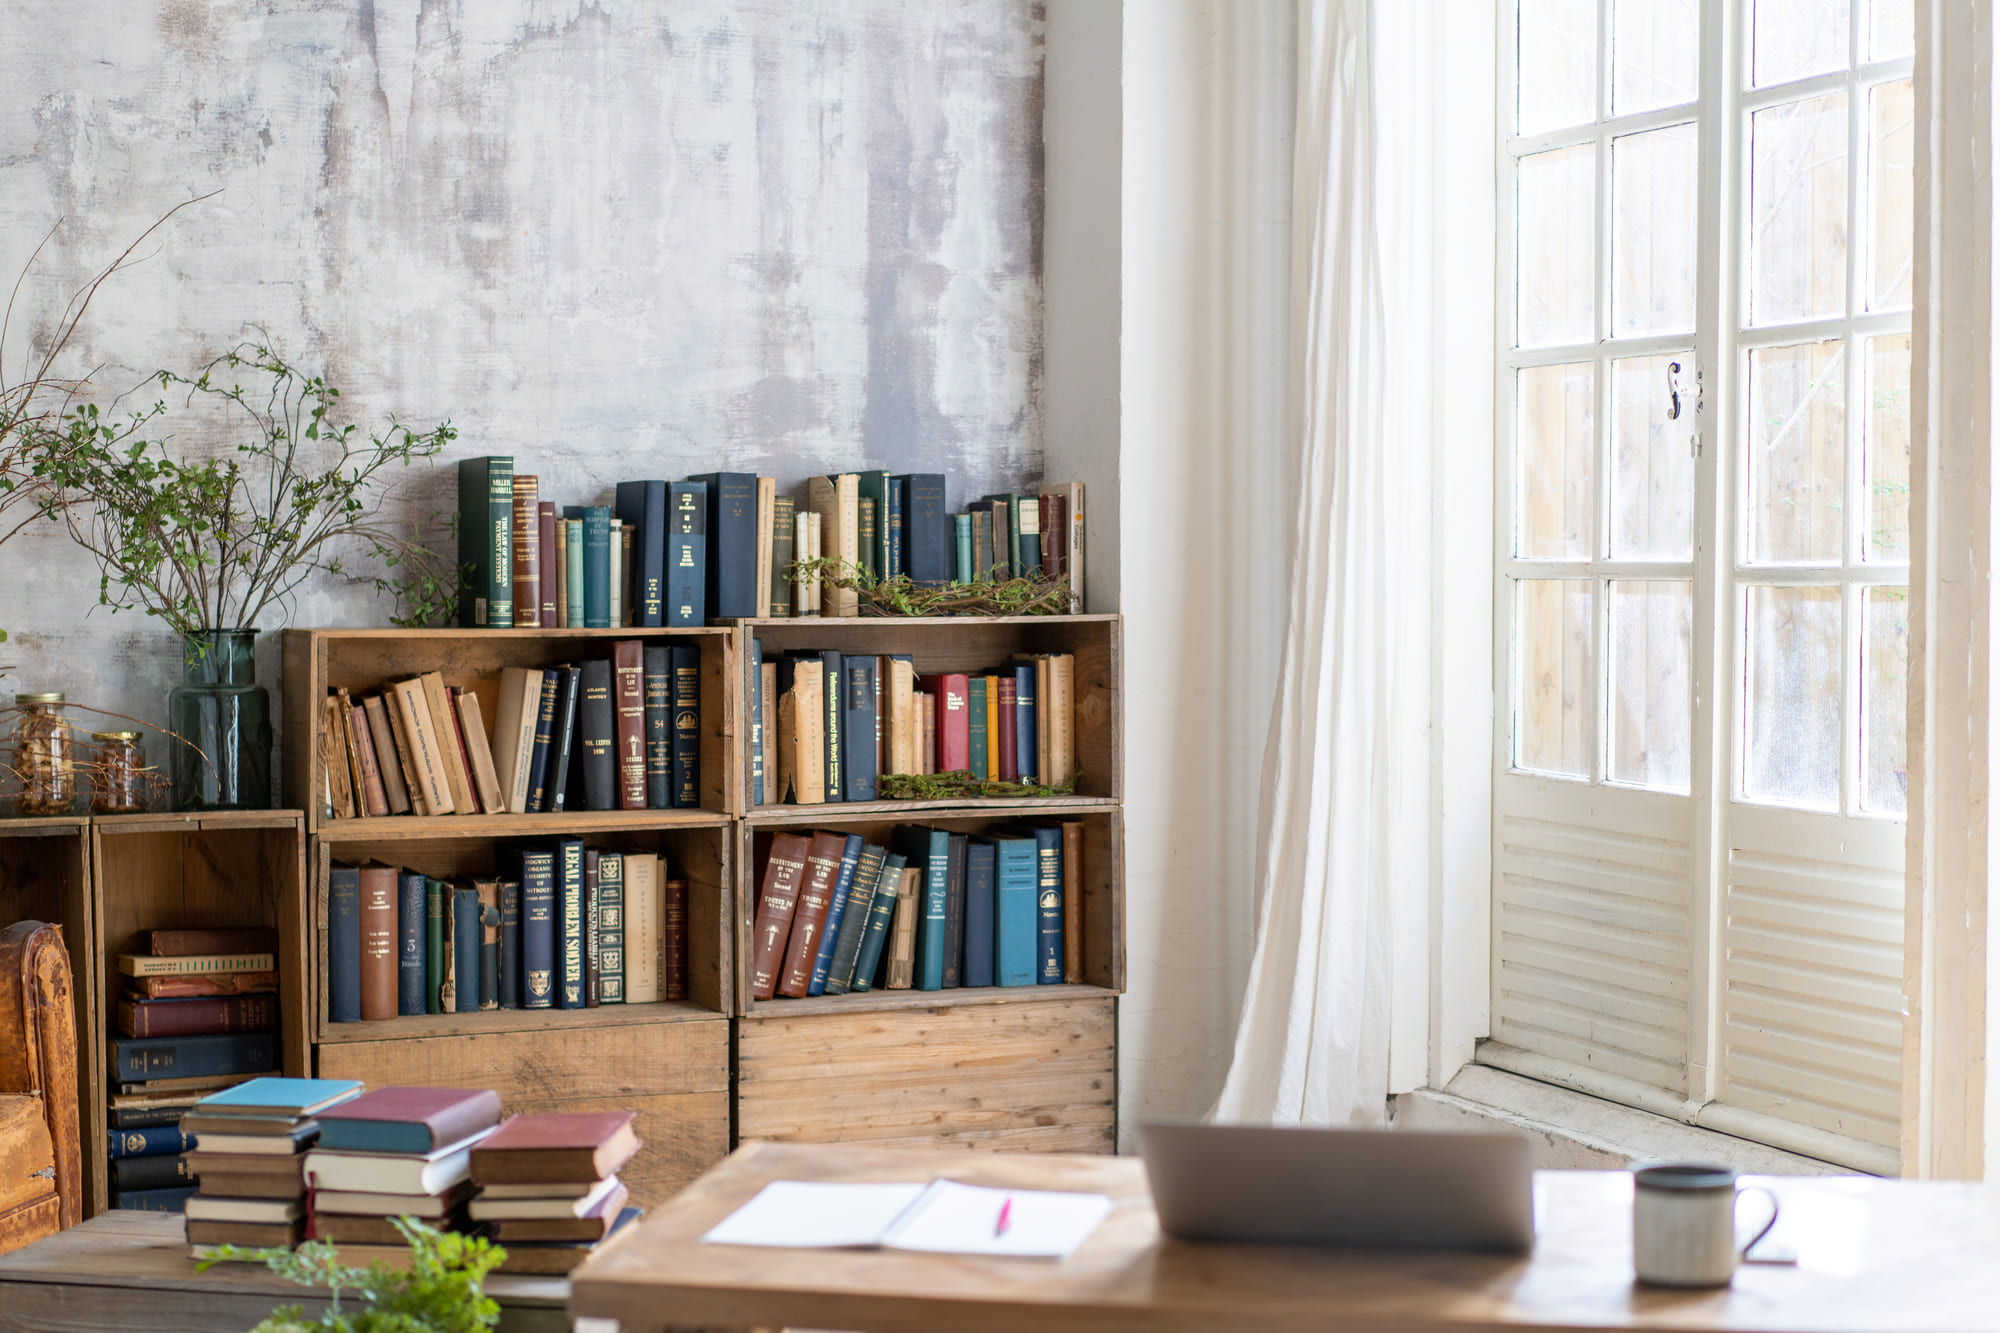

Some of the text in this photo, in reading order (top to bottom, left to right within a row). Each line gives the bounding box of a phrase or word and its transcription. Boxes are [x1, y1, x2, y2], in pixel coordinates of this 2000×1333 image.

[502, 547, 508, 557] OF
[655, 720, 664, 728] 54
[774, 882, 791, 891] Second
[566, 846, 580, 982] LEGAL PROBLEM SOLVER
[407, 939, 416, 952] 3
